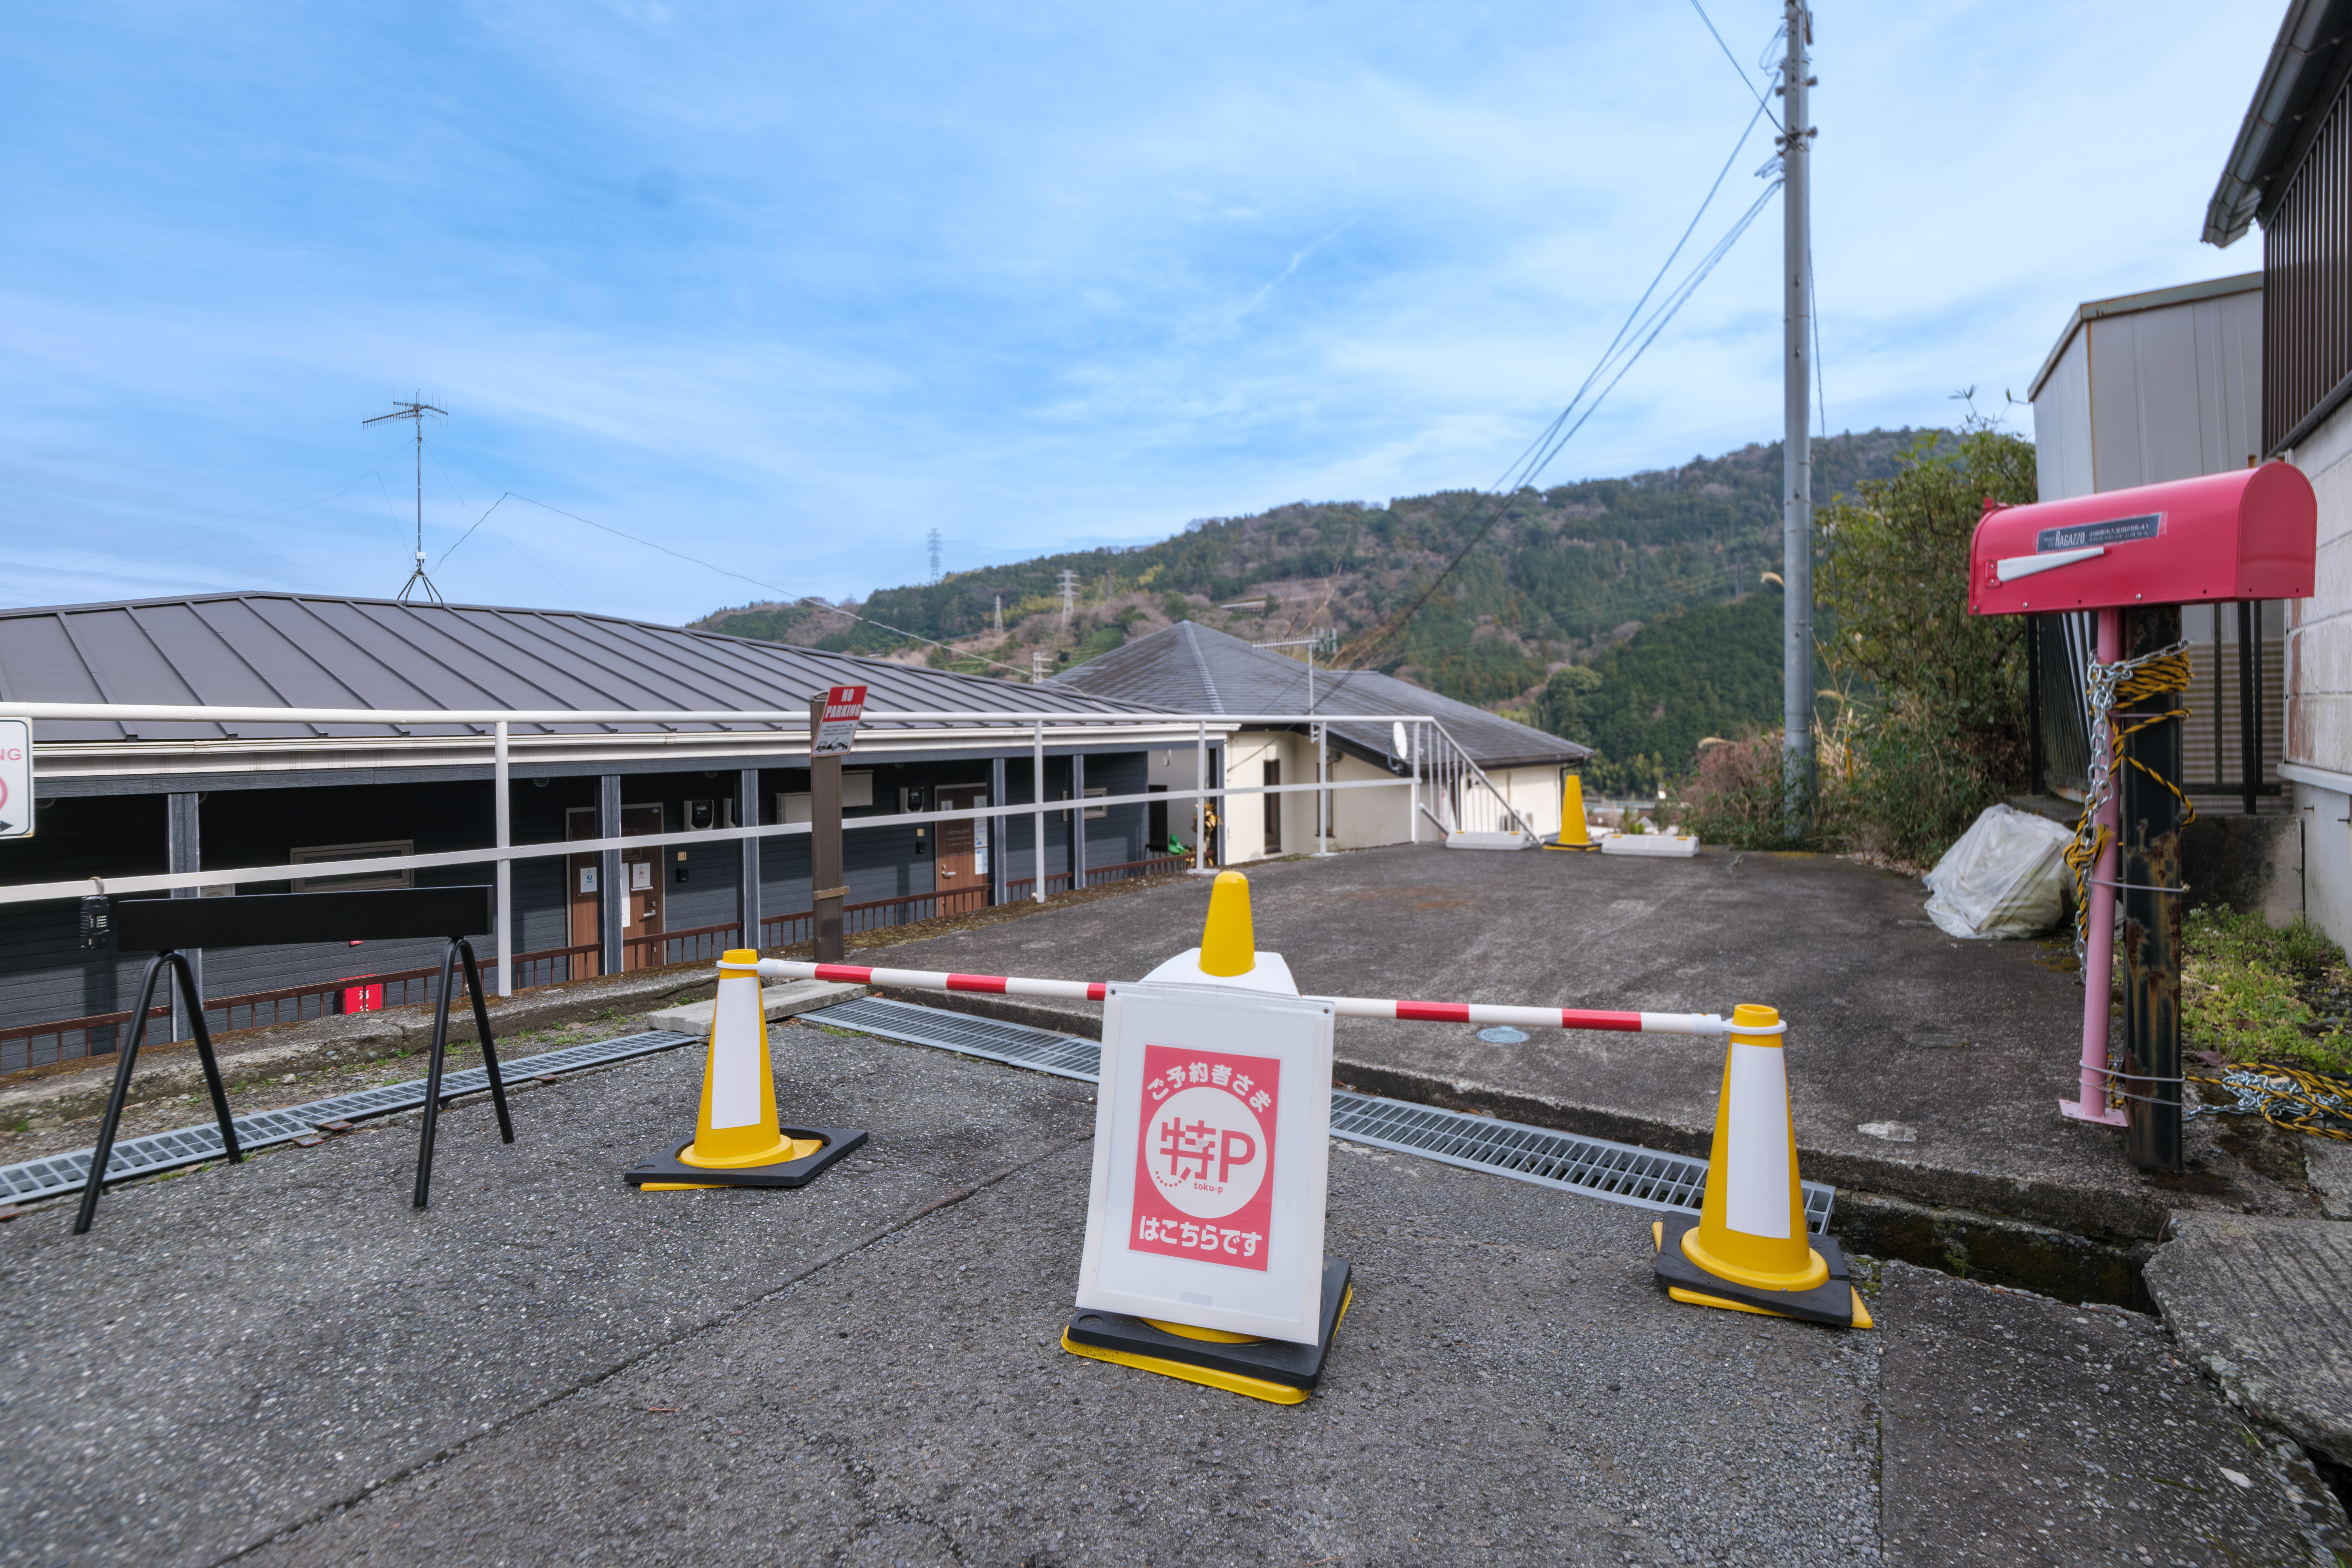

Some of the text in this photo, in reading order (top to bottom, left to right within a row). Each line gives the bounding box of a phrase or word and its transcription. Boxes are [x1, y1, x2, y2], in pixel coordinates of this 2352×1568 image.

[841, 688, 854, 702] NO
[825, 704, 862, 718] PARKING
[1147, 1062, 1272, 1113] ご予約者さま
[1160, 1117, 1256, 1183] 特P
[1194, 1182, 1223, 1194] toku-p
[1139, 1215, 1262, 1257] はこちらです
